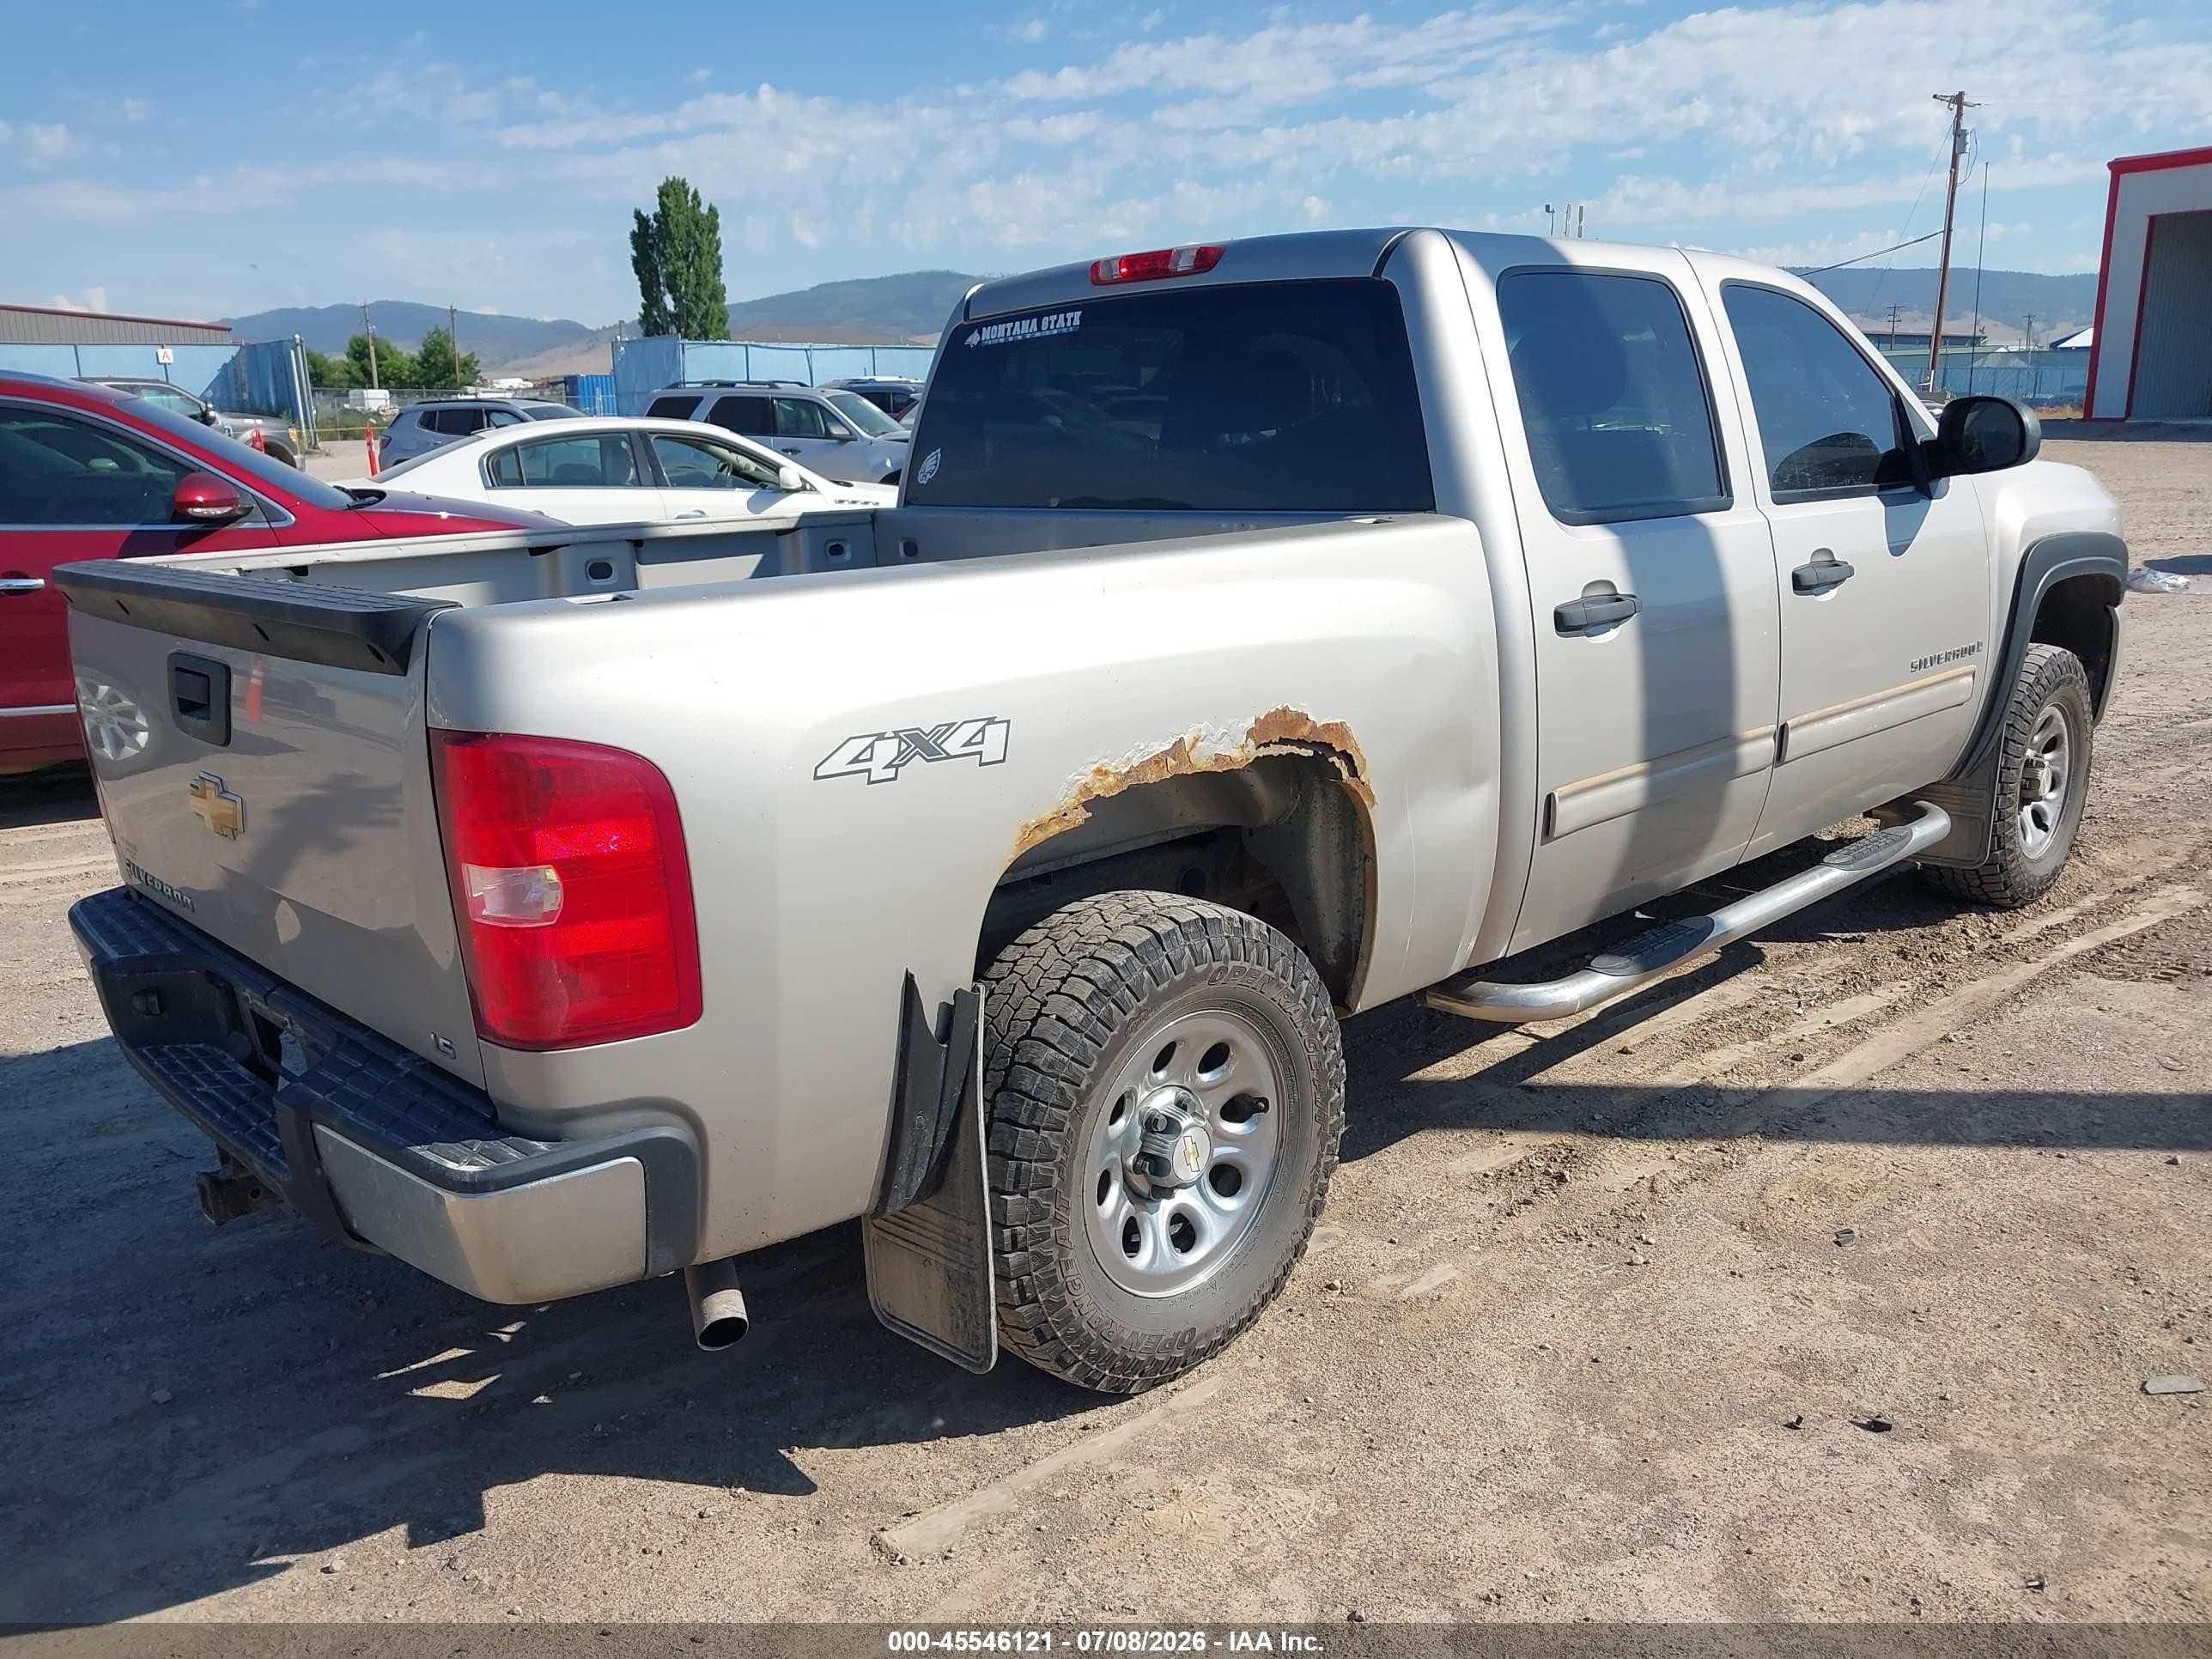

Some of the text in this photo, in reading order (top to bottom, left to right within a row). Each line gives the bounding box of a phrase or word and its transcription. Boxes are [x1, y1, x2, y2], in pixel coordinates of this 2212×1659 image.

[981, 318, 1037, 341] MONTANA
[1042, 310, 1083, 331] STATE
[162, 350, 171, 361] A
[1207, 965, 1278, 994] OPEN
[1270, 988, 1324, 1072] RANGE
[430, 1031, 457, 1060] LS
[1120, 1326, 1197, 1355] OPEN
